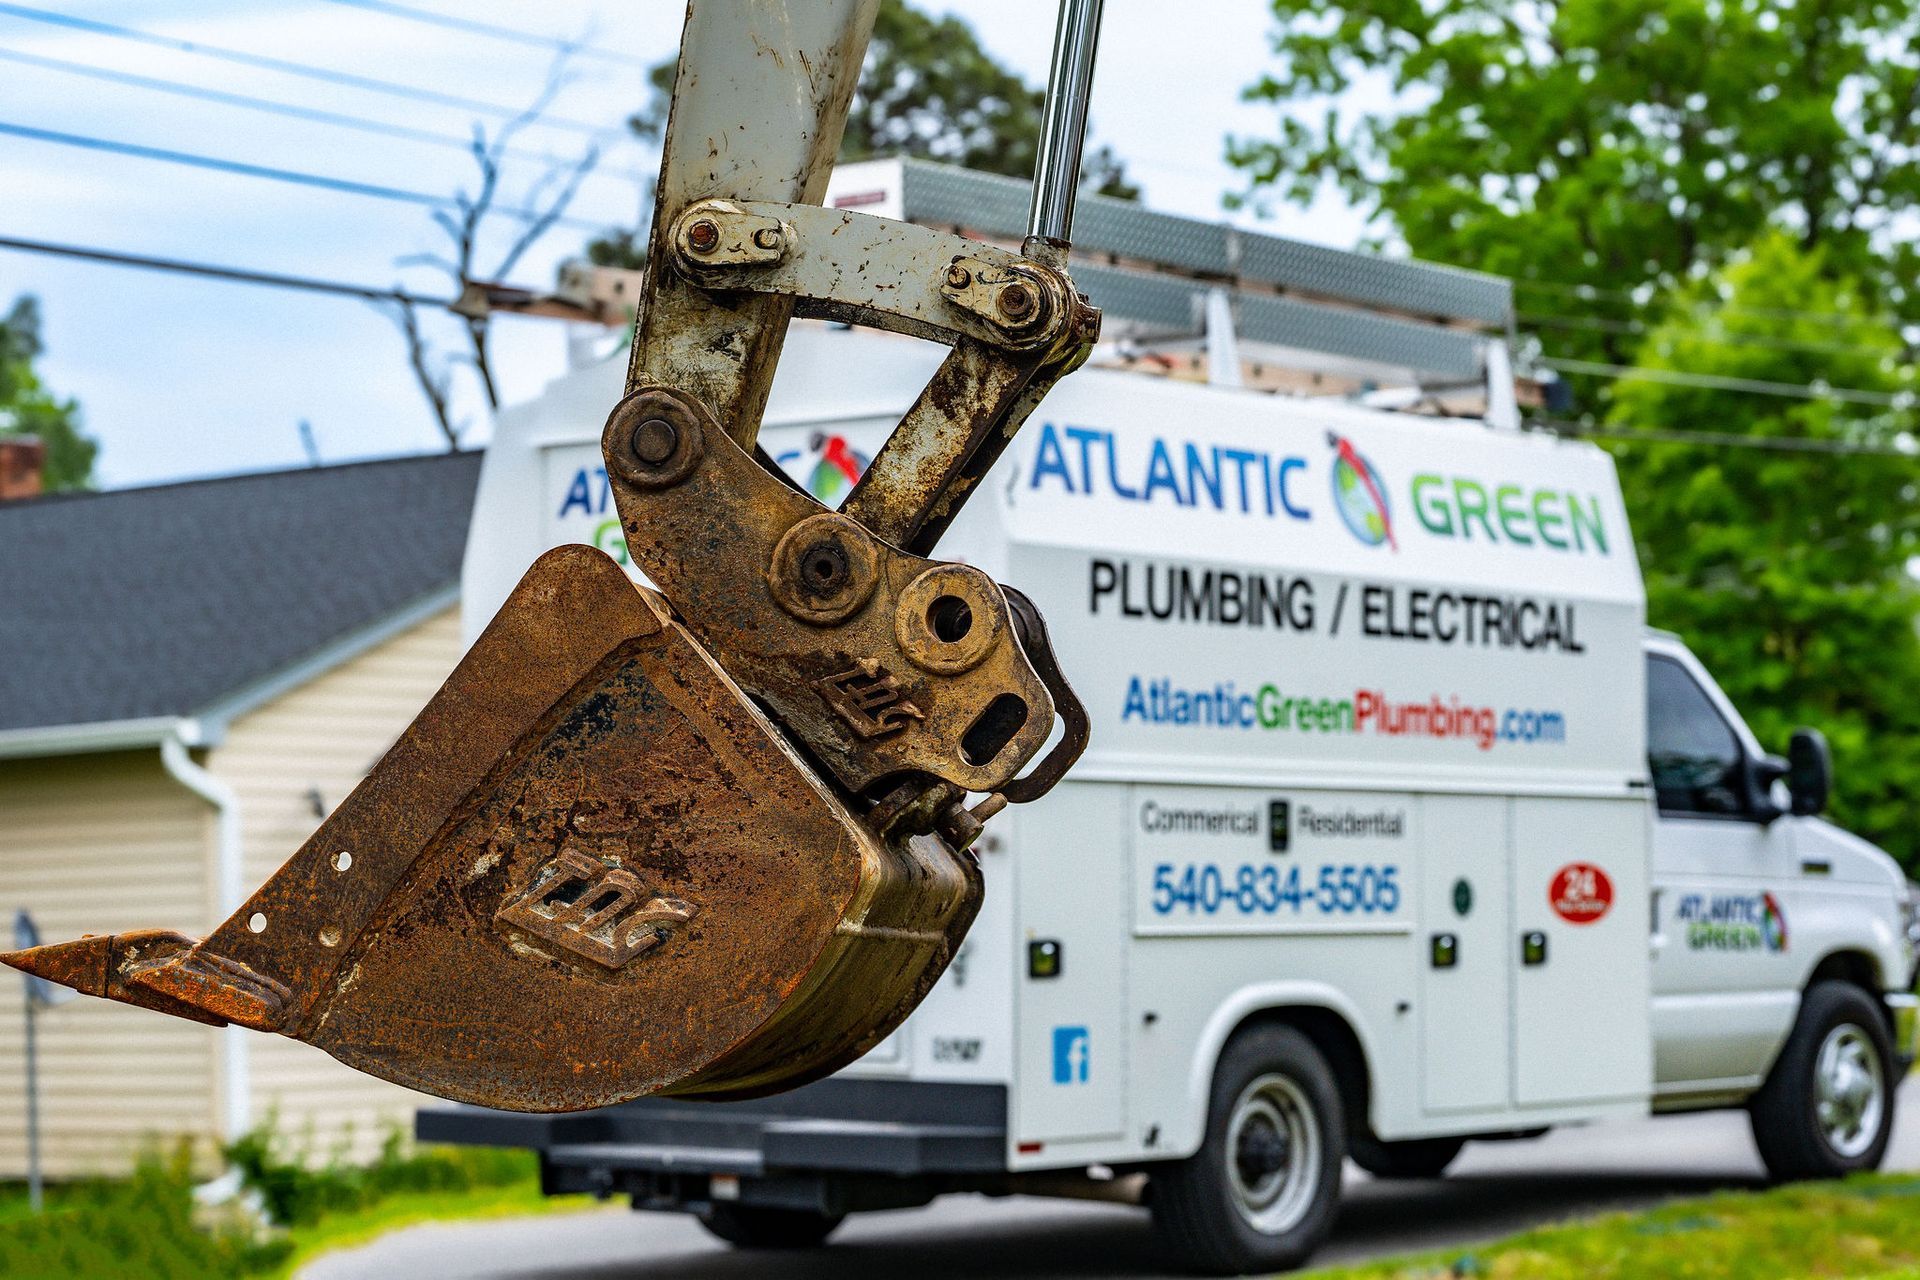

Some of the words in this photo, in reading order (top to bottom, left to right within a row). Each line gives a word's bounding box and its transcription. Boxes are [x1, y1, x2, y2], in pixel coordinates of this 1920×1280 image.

[1030, 421, 1313, 520] ATLANTIC
[1410, 472, 1611, 556] GREEN
[1089, 558, 1315, 632] PLUMBING
[1330, 582, 1349, 636] /
[1361, 584, 1585, 654] ELECTRICAL
[1122, 674, 1566, 752] AtlanticGreenPlumbing.com
[1299, 804, 1404, 838] Residential
[1153, 863, 1401, 916] 540-834-5505
